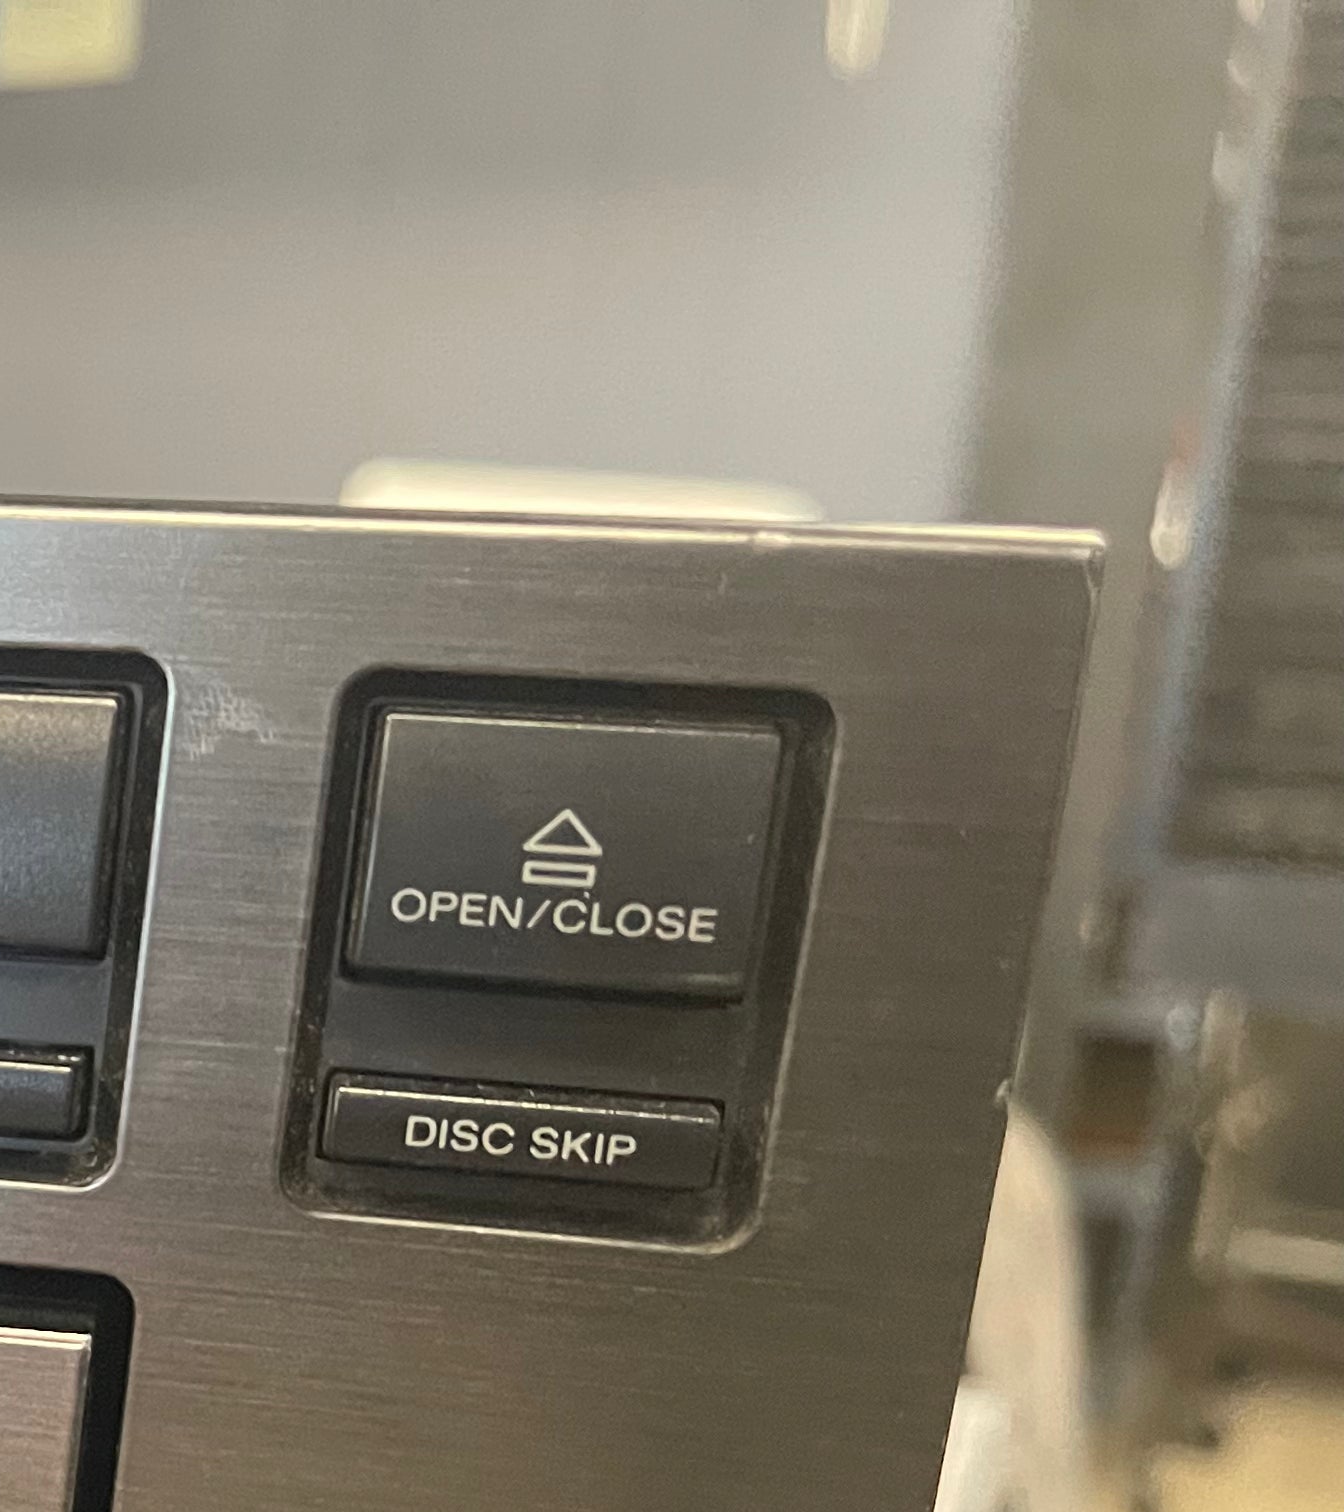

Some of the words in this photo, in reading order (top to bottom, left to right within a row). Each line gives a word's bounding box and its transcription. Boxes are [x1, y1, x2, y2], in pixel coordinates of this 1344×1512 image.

[390, 888, 719, 942] OPEN/CLOSE
[405, 1115, 515, 1156] DISC
[529, 1126, 638, 1165] SKIP
